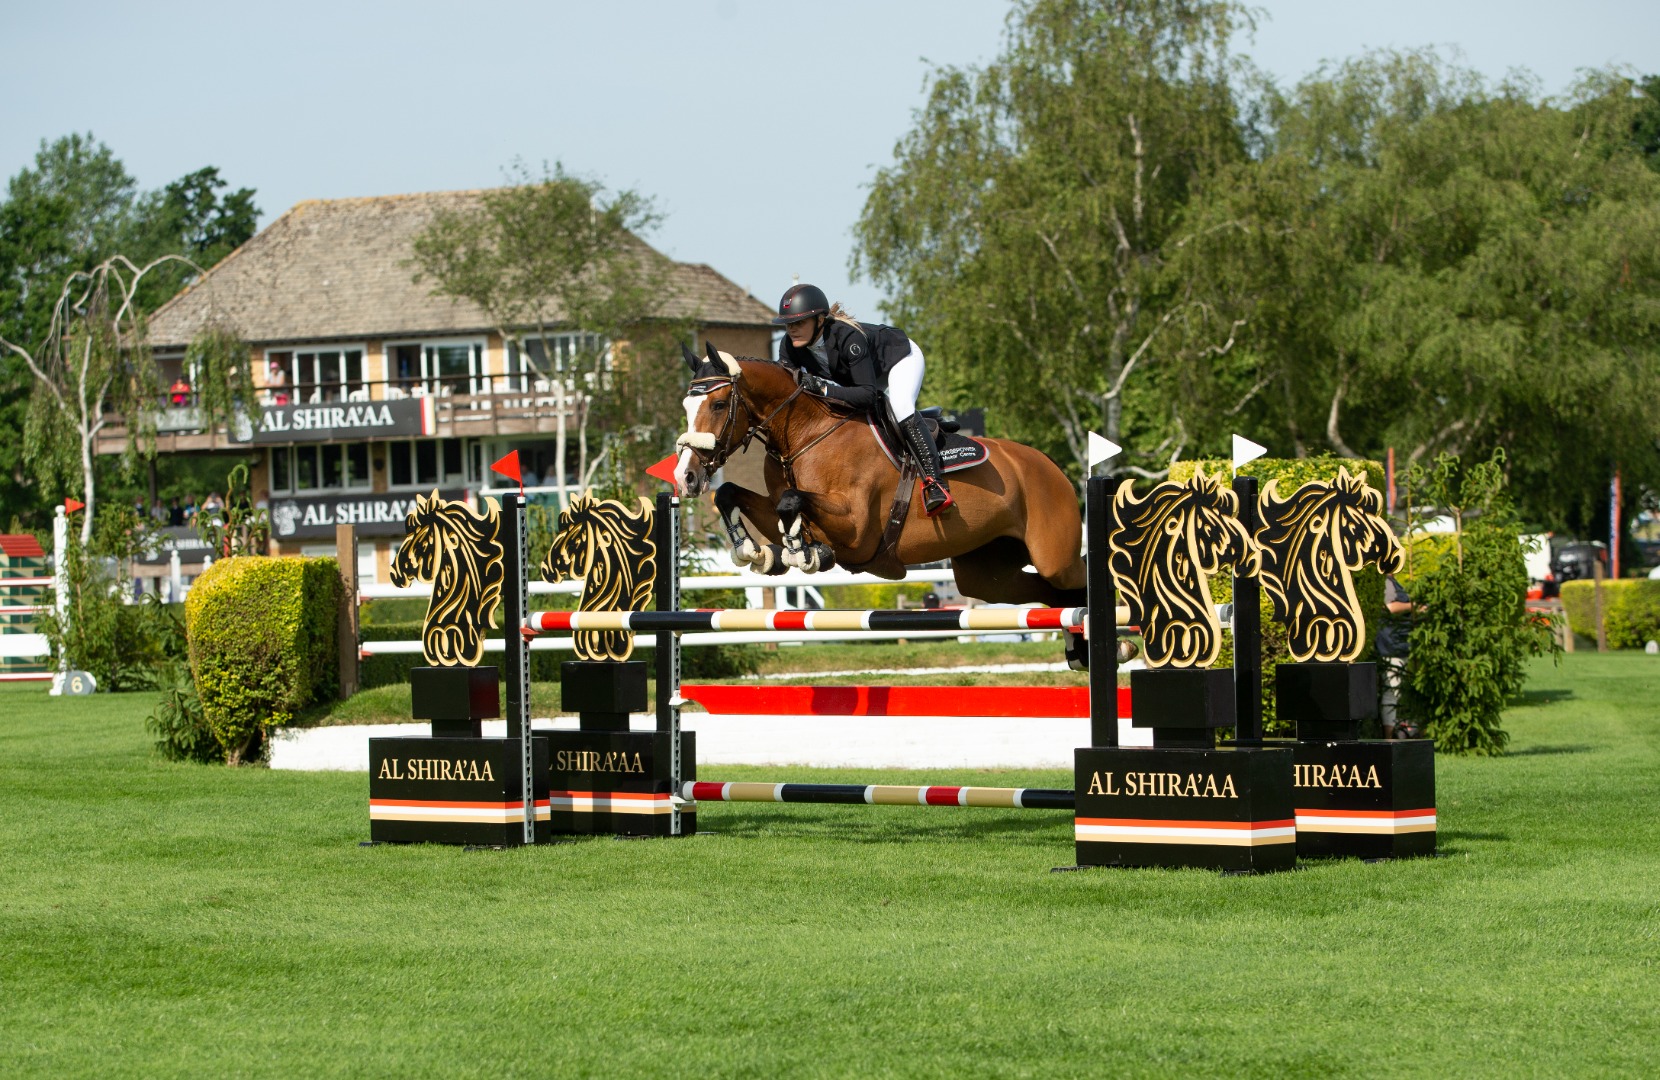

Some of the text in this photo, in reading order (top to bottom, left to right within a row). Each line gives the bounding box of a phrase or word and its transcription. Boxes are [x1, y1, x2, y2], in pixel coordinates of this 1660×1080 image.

[259, 404, 396, 432] AL SHIRA'AA
[302, 500, 418, 526] AL SHIRA'A
[71, 676, 83, 693] 6
[378, 758, 495, 782] AL SHIRA'AA
[557, 750, 645, 773] SHIRA'AA
[1087, 771, 1239, 799] AL SHIRA'AA
